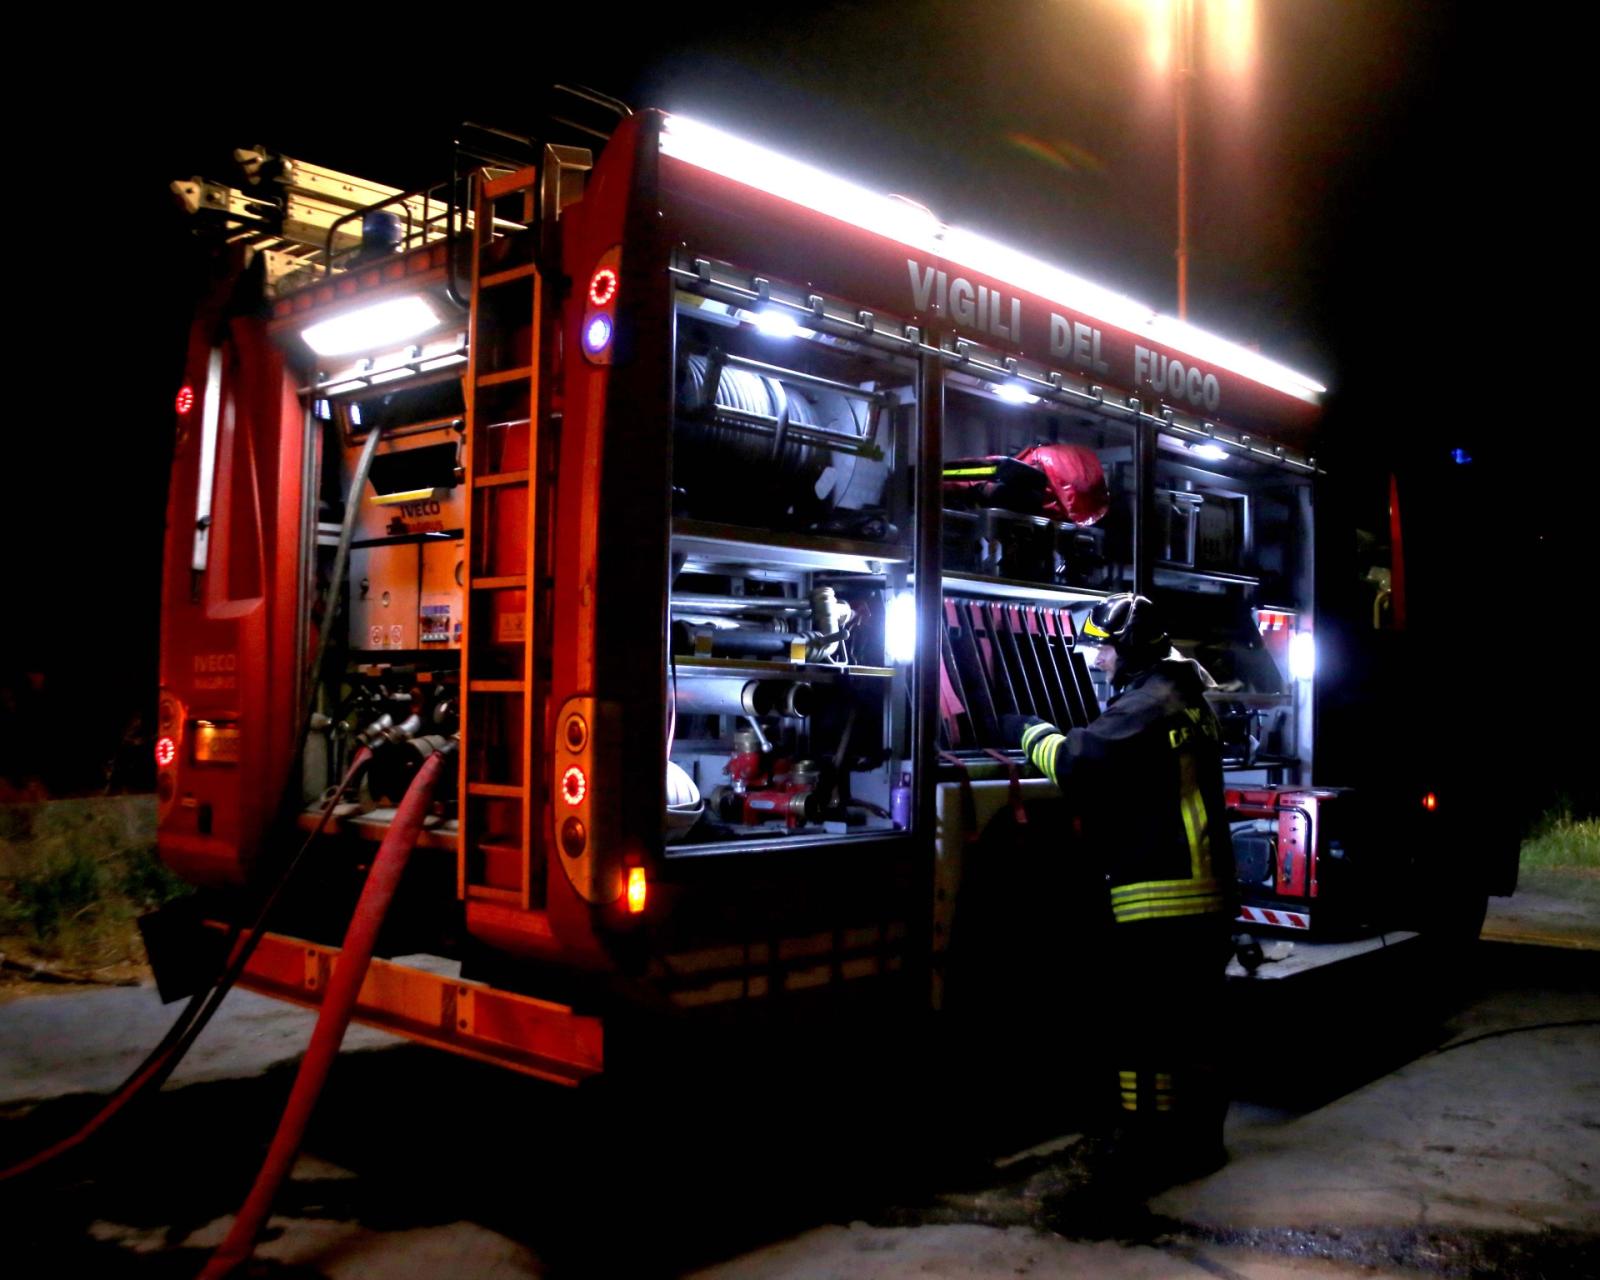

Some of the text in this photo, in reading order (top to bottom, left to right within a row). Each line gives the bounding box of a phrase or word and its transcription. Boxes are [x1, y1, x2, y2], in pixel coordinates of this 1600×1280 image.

[906, 259, 1220, 413] VIGILI DEL FUOCO
[401, 500, 440, 519] IVECO
[193, 653, 236, 673] IVECO
